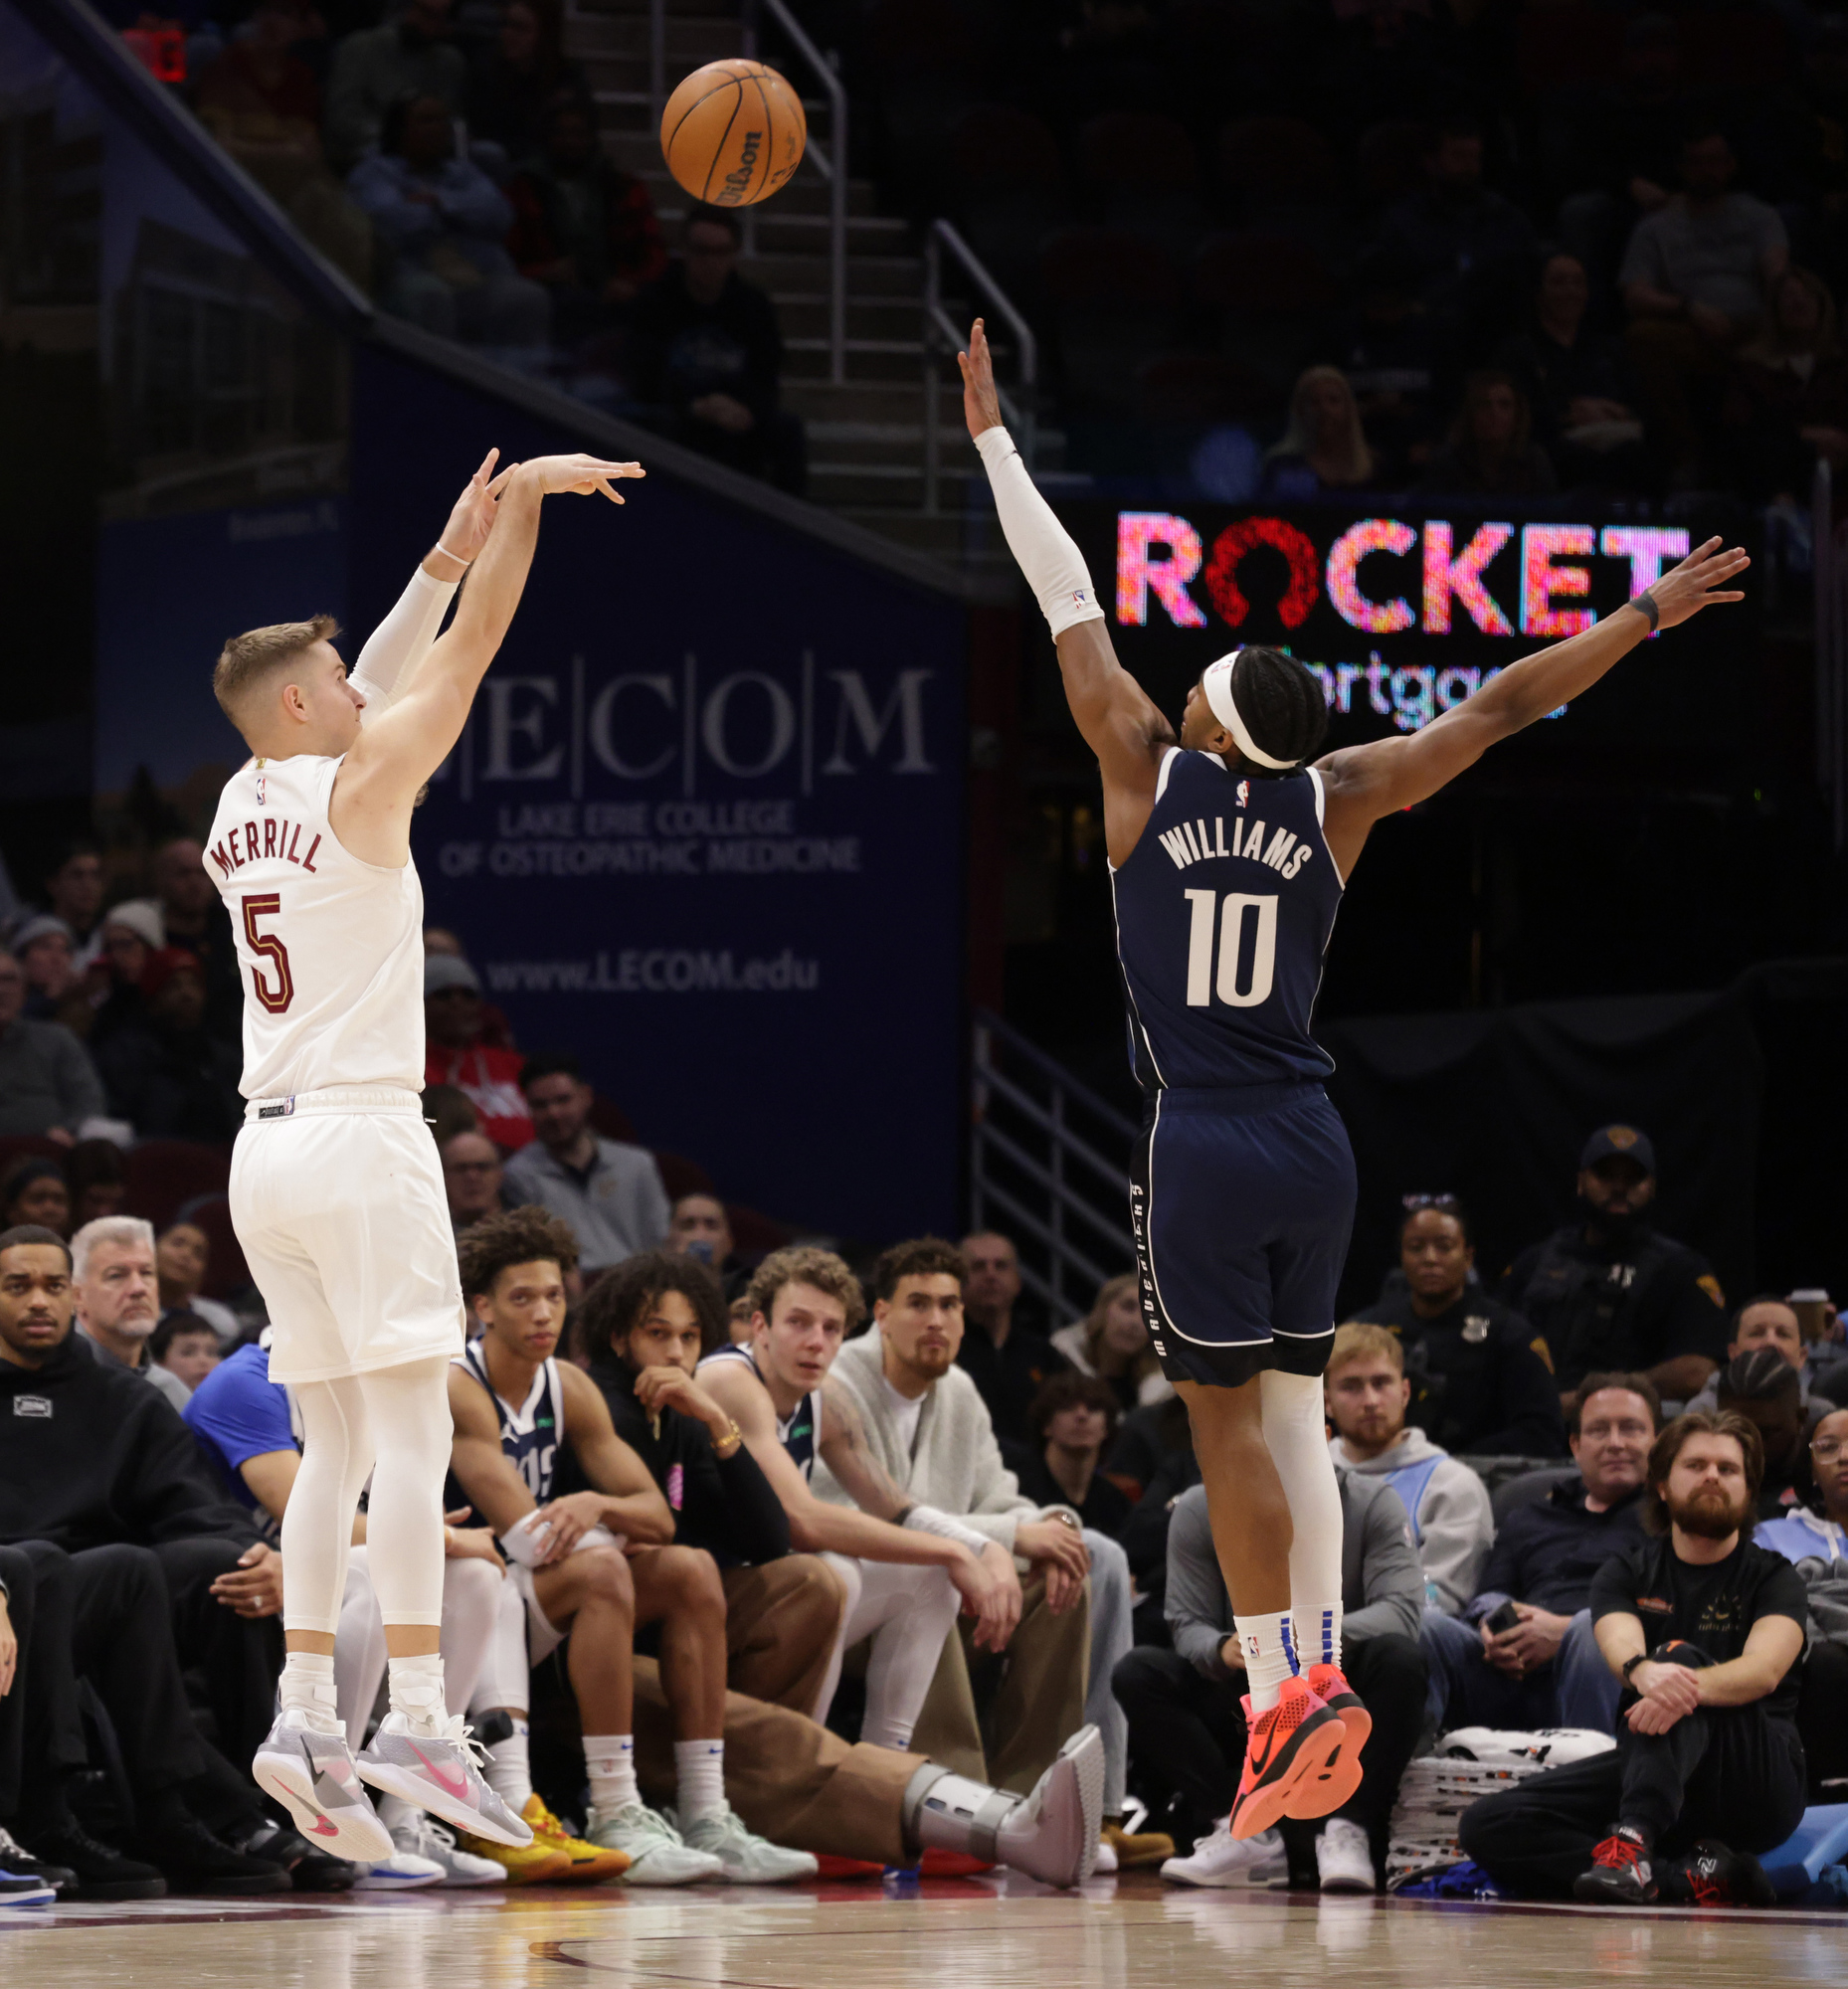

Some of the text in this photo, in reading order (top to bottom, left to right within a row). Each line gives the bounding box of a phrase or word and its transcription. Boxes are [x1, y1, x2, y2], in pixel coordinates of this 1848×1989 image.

[712, 130, 763, 205] Wilson
[1116, 511, 1690, 639] ROCKET
[210, 817, 321, 881] MERRILL
[499, 803, 575, 837] LAKE
[655, 800, 794, 835] COLLEGE
[1158, 816, 1313, 880] WILLIAMS
[439, 836, 861, 876] OF OSTEOPATHIC MEDICINE
[242, 892, 294, 1013] 5
[487, 948, 819, 993] www.LECOM.edu
[1185, 888, 1279, 1007] 10
